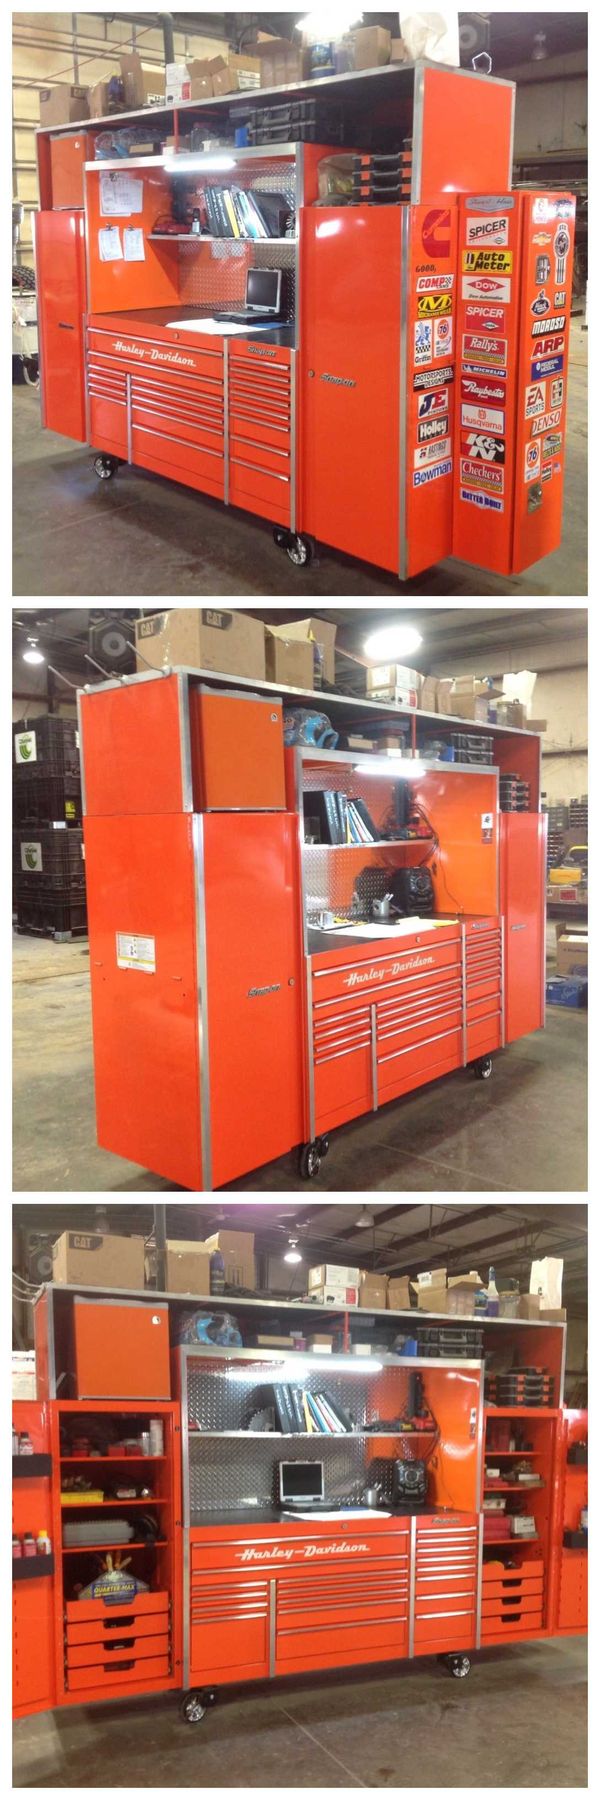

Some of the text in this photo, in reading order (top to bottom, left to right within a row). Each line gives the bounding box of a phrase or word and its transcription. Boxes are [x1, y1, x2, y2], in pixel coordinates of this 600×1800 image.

[469, 219, 506, 238] SPICER
[477, 252, 505, 262] Auto
[475, 261, 510, 271] Meter
[419, 277, 445, 289] COMP
[554, 291, 566, 306] CAT
[466, 306, 504, 318] SPICER
[439, 325, 448, 334] 76
[532, 315, 566, 335] MOROSO
[470, 337, 499, 352] Rally's
[532, 336, 564, 357] ARP
[112, 341, 197, 367] Harley-Davidson
[473, 366, 505, 376] MICHELIN
[420, 390, 447, 417] JE
[527, 386, 543, 407] EA
[525, 402, 544, 417] SPORTS
[420, 419, 447, 437] Holley
[462, 415, 502, 431] Husqvarna
[532, 411, 561, 434] DENSO
[528, 449, 538, 462] 76
[413, 462, 452, 486] Bowman
[206, 609, 223, 627] CAT
[140, 621, 154, 638] CAT
[343, 955, 436, 987] Harley-Davidson
[73, 1236, 91, 1249] CAT
[235, 1542, 371, 1561] Harley-Davidson
